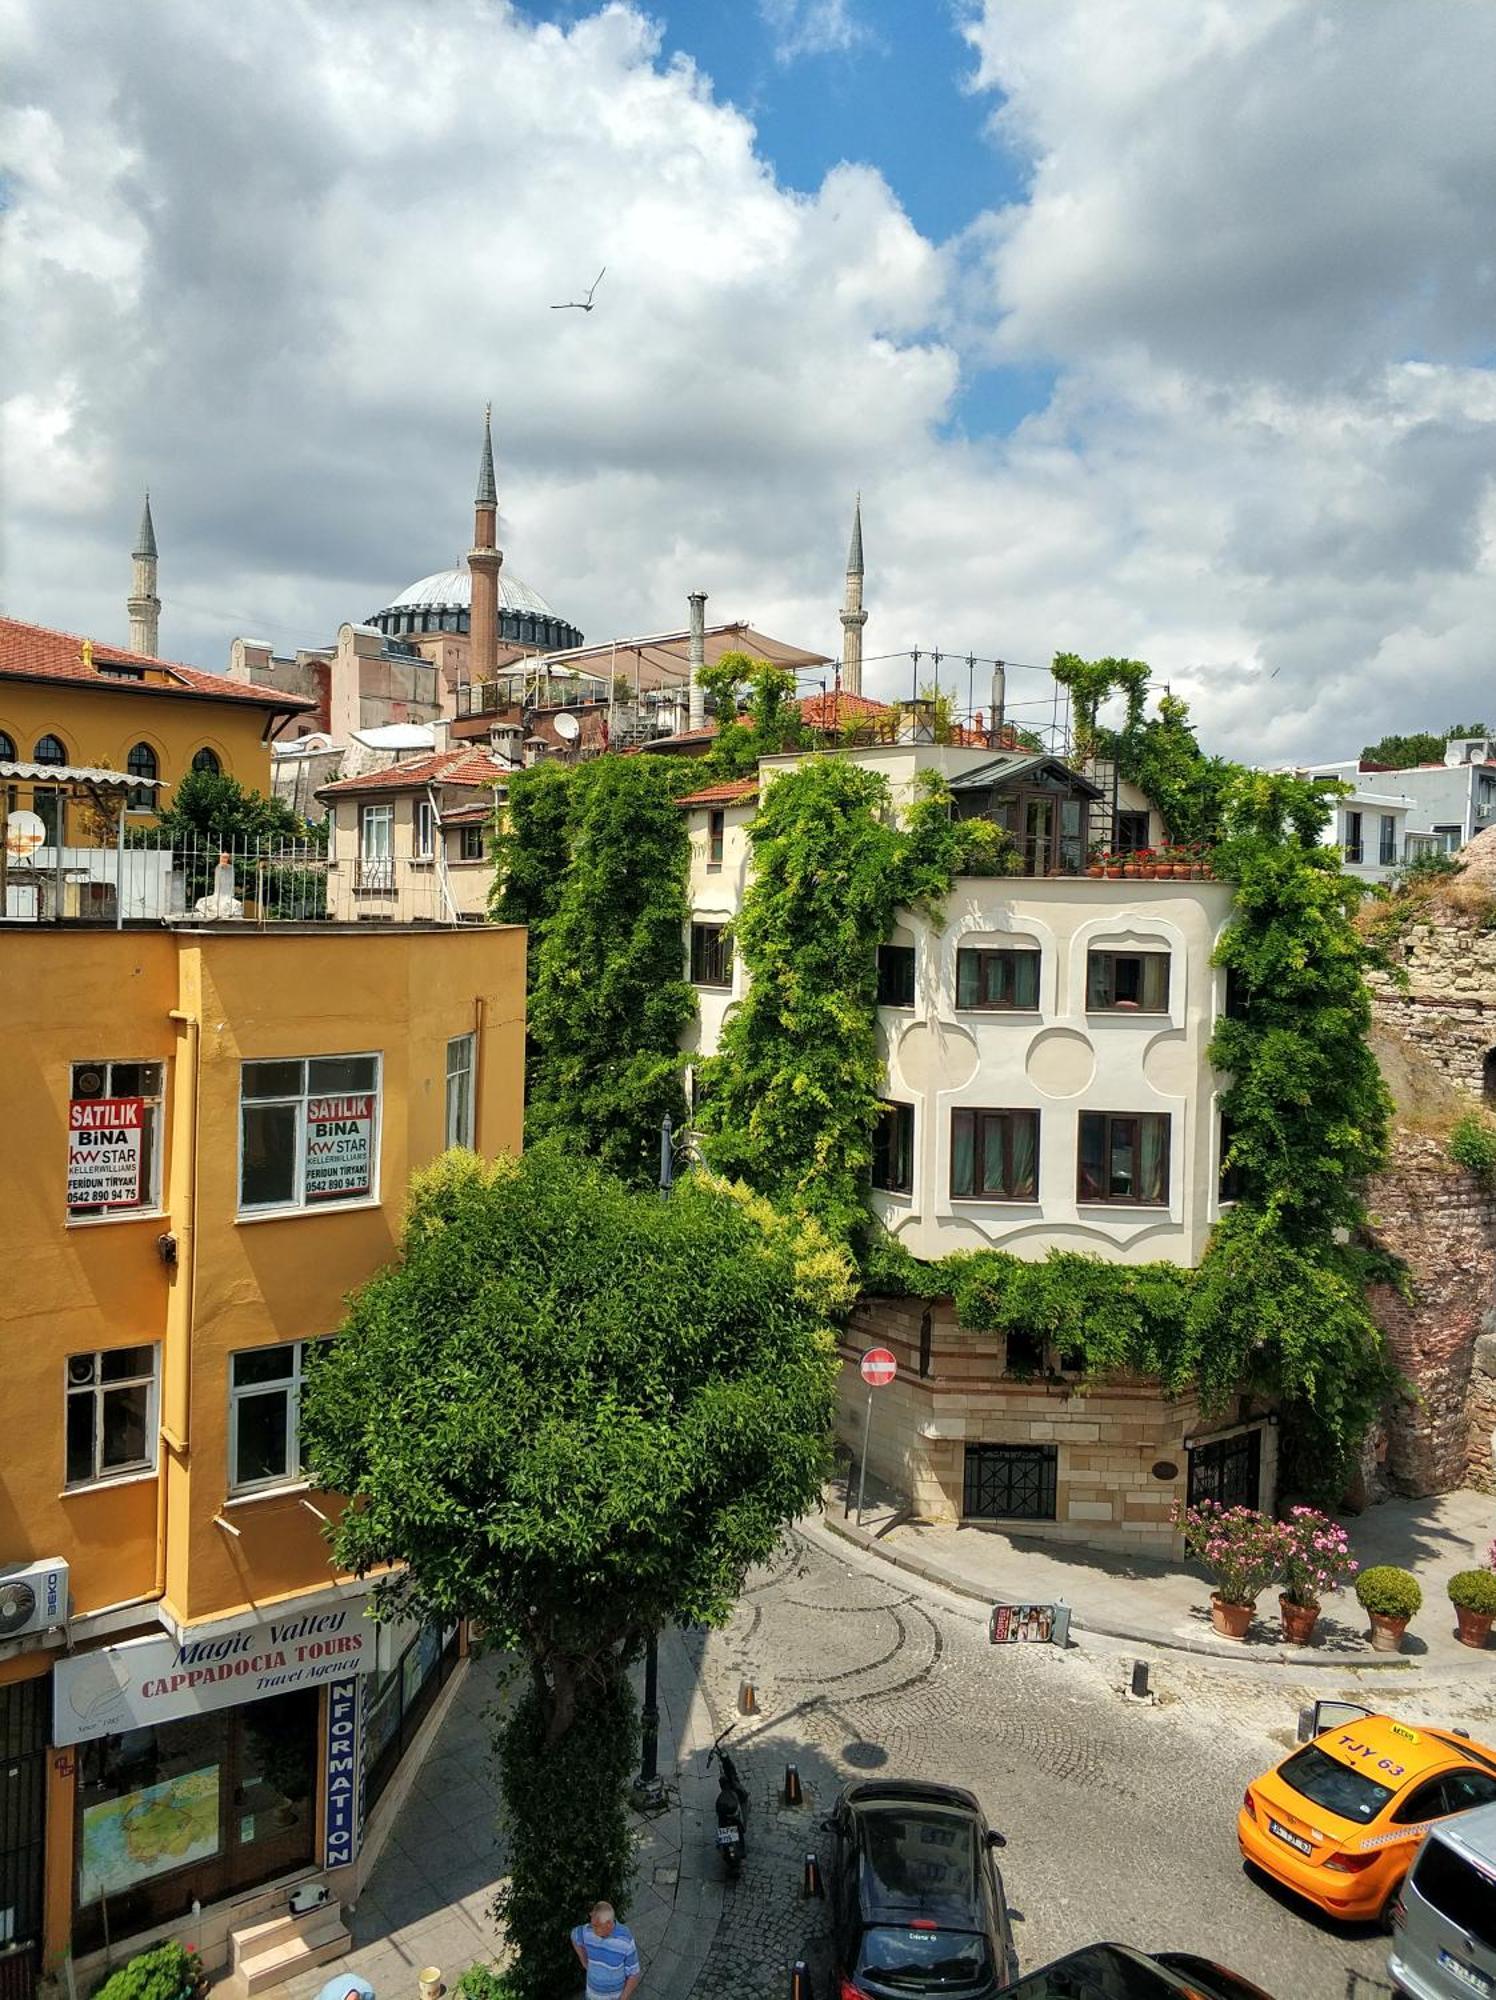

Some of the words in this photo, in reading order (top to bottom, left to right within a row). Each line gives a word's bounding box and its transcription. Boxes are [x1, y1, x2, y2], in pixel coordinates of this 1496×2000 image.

[71, 1103, 138, 1127] SATILIK
[309, 1096, 368, 1119] SATILIK
[69, 1145, 101, 1165] kw
[101, 1149, 136, 1164] STAR
[308, 1137, 335, 1156] kw
[336, 1139, 367, 1153] STAR
[67, 1191, 90, 1203] 0542
[92, 1190, 110, 1202] 890
[111, 1189, 122, 1199] 94
[125, 1188, 136, 1199] 75
[306, 1181, 326, 1192] 0542
[328, 1179, 344, 1189] 890
[345, 1177, 355, 1187] 94
[357, 1176, 367, 1186] 75
[47, 1573, 57, 1616] BEKO
[171, 1632, 255, 1669] Magic
[270, 1611, 348, 1645] Valley
[142, 1651, 287, 1698] CAPPADOCIA
[295, 1633, 363, 1663] TOURS
[256, 1670, 303, 1690] Travel
[305, 1656, 360, 1679] Agency
[1338, 1735, 1377, 1757] TJY
[1377, 1759, 1405, 1776] 63
[328, 1683, 354, 1865] NFORMATION
